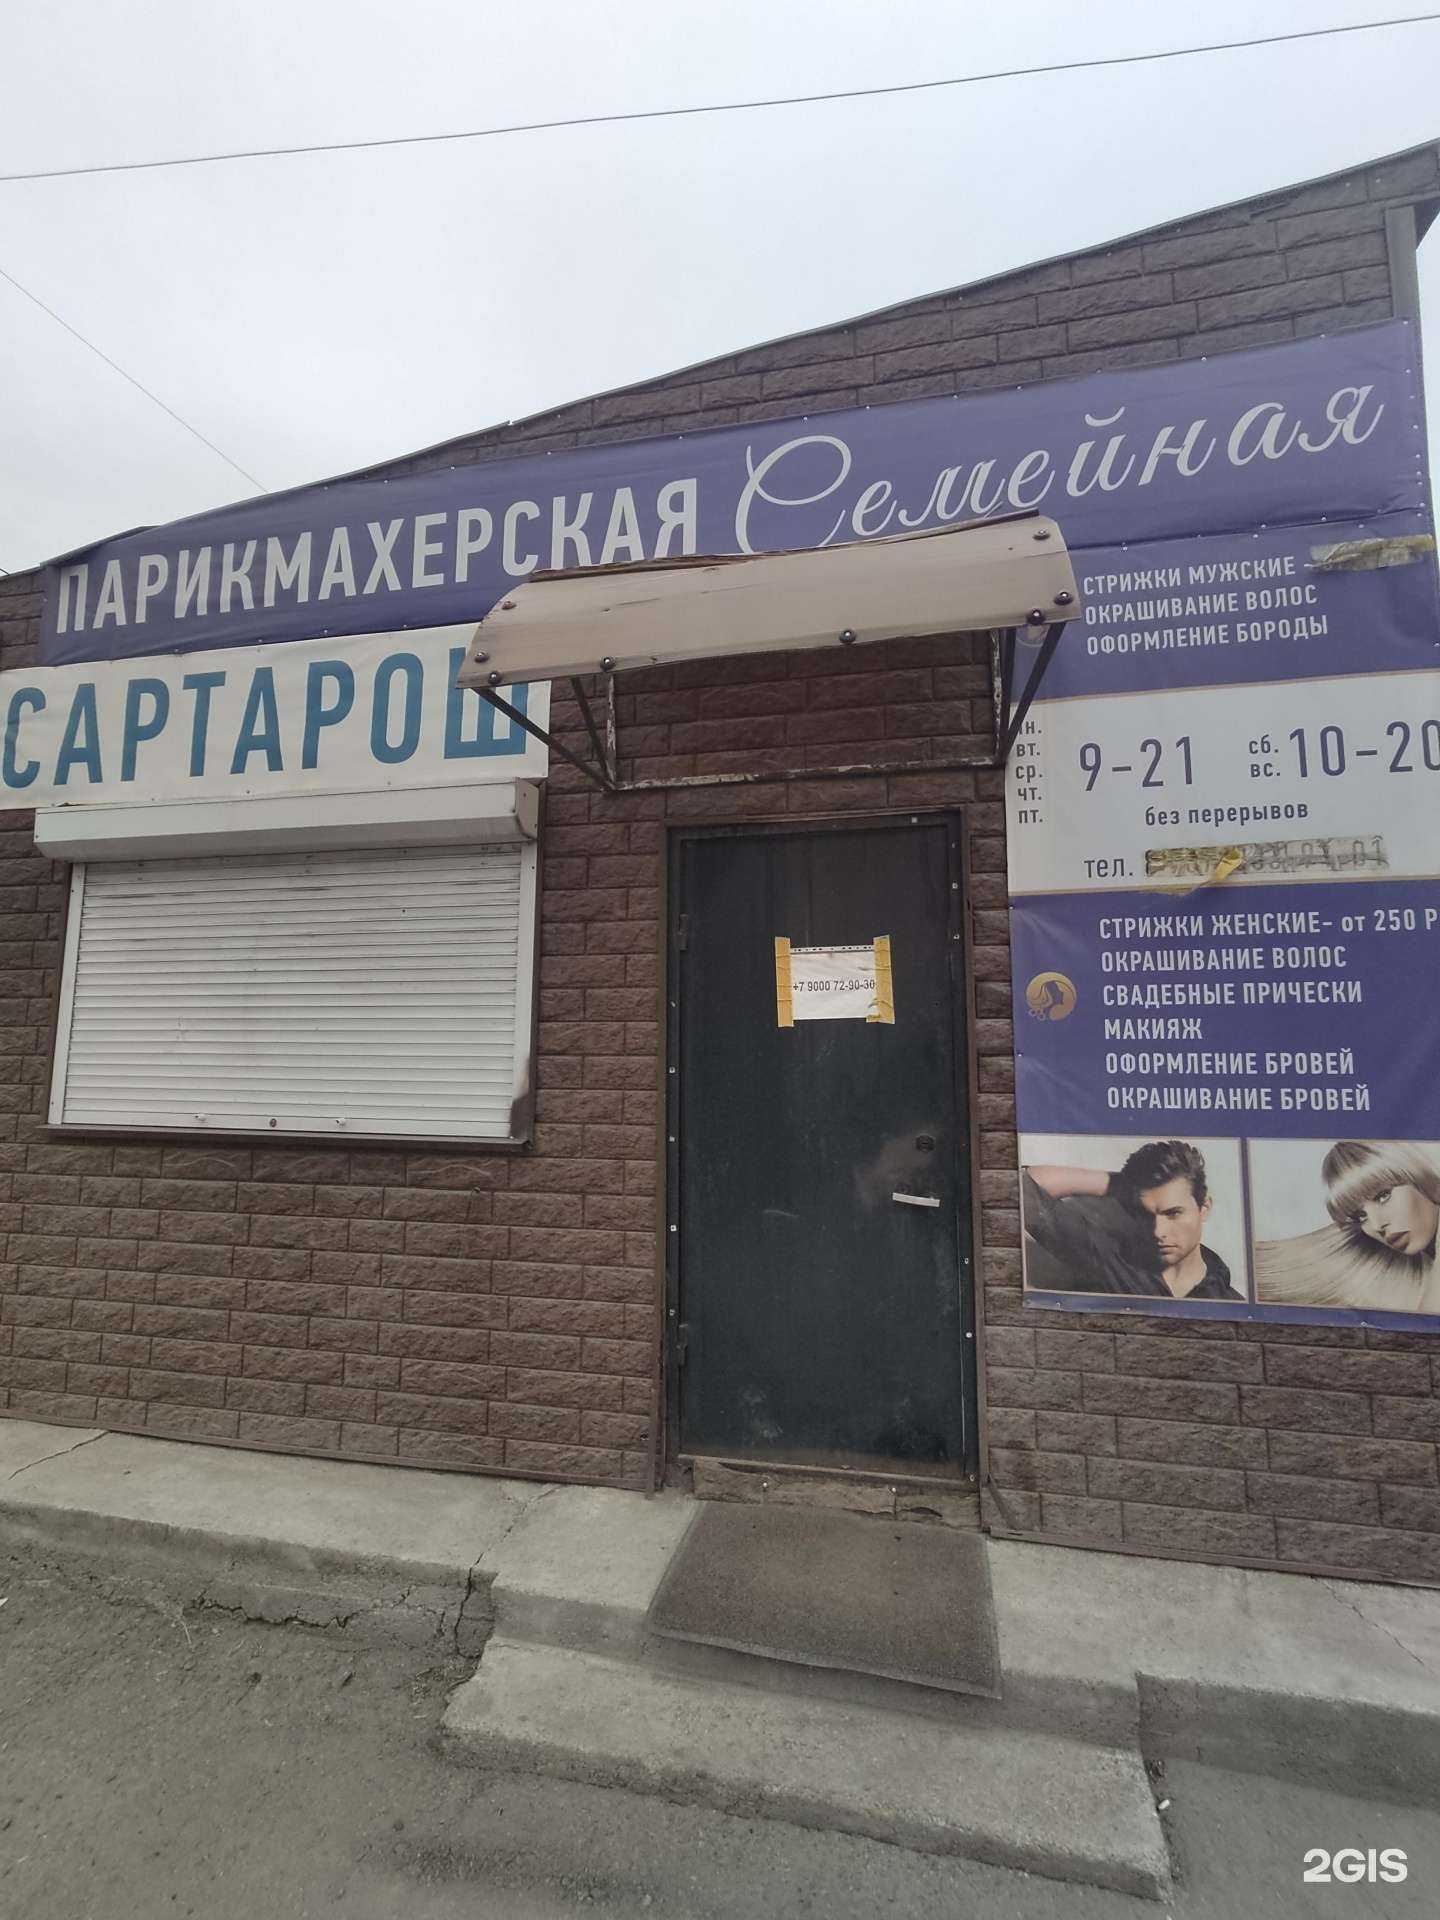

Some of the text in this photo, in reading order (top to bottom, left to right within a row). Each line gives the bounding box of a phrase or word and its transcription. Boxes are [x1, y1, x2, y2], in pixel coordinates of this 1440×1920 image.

[56, 383, 1386, 634] ПАРИКМАХЕРСКАЯ Семейная
[1083, 568, 1182, 596] СТРИЖКИ
[1188, 556, 1297, 585] МУЖСКИЕ
[1085, 584, 1318, 625] ОКРАШИВАНИЕ ВОЛОС
[1086, 615, 1329, 656] ОФОРМЛЕНИЕ БОРОДЫ
[1, 646, 529, 790] САРТАРОШ
[1016, 742, 1041, 758] вт.
[1248, 733, 1280, 756] сб.
[1015, 764, 1043, 783] ср.
[1079, 736, 1194, 792] 9-21
[1249, 761, 1282, 778] вс.
[1017, 787, 1042, 801] чт.
[1018, 809, 1044, 824] пт.
[1144, 801, 1309, 828] без перерывов
[1083, 858, 1134, 879] тел.
[1099, 915, 1204, 939] СТРИЖКИ
[1341, 915, 1366, 932] от
[1374, 908, 1416, 931] 250
[1424, 908, 1438, 930] Р
[1101, 946, 1347, 972] ОКРАШИВАНИЕ ВОЛОС
[792, 979, 876, 992] +7 9000 72-90-30
[1102, 981, 1363, 1008] СВАДЕБНЫЕ ПРИЧЕСКИ
[1104, 1018, 1203, 1040] МАКИЯЖ
[1105, 1047, 1354, 1075] ОФОРМЛЕНИЕ БРОВЕЙ
[1107, 1083, 1371, 1111] ОКРАШИВАНИЕ БРОВЕЙ
